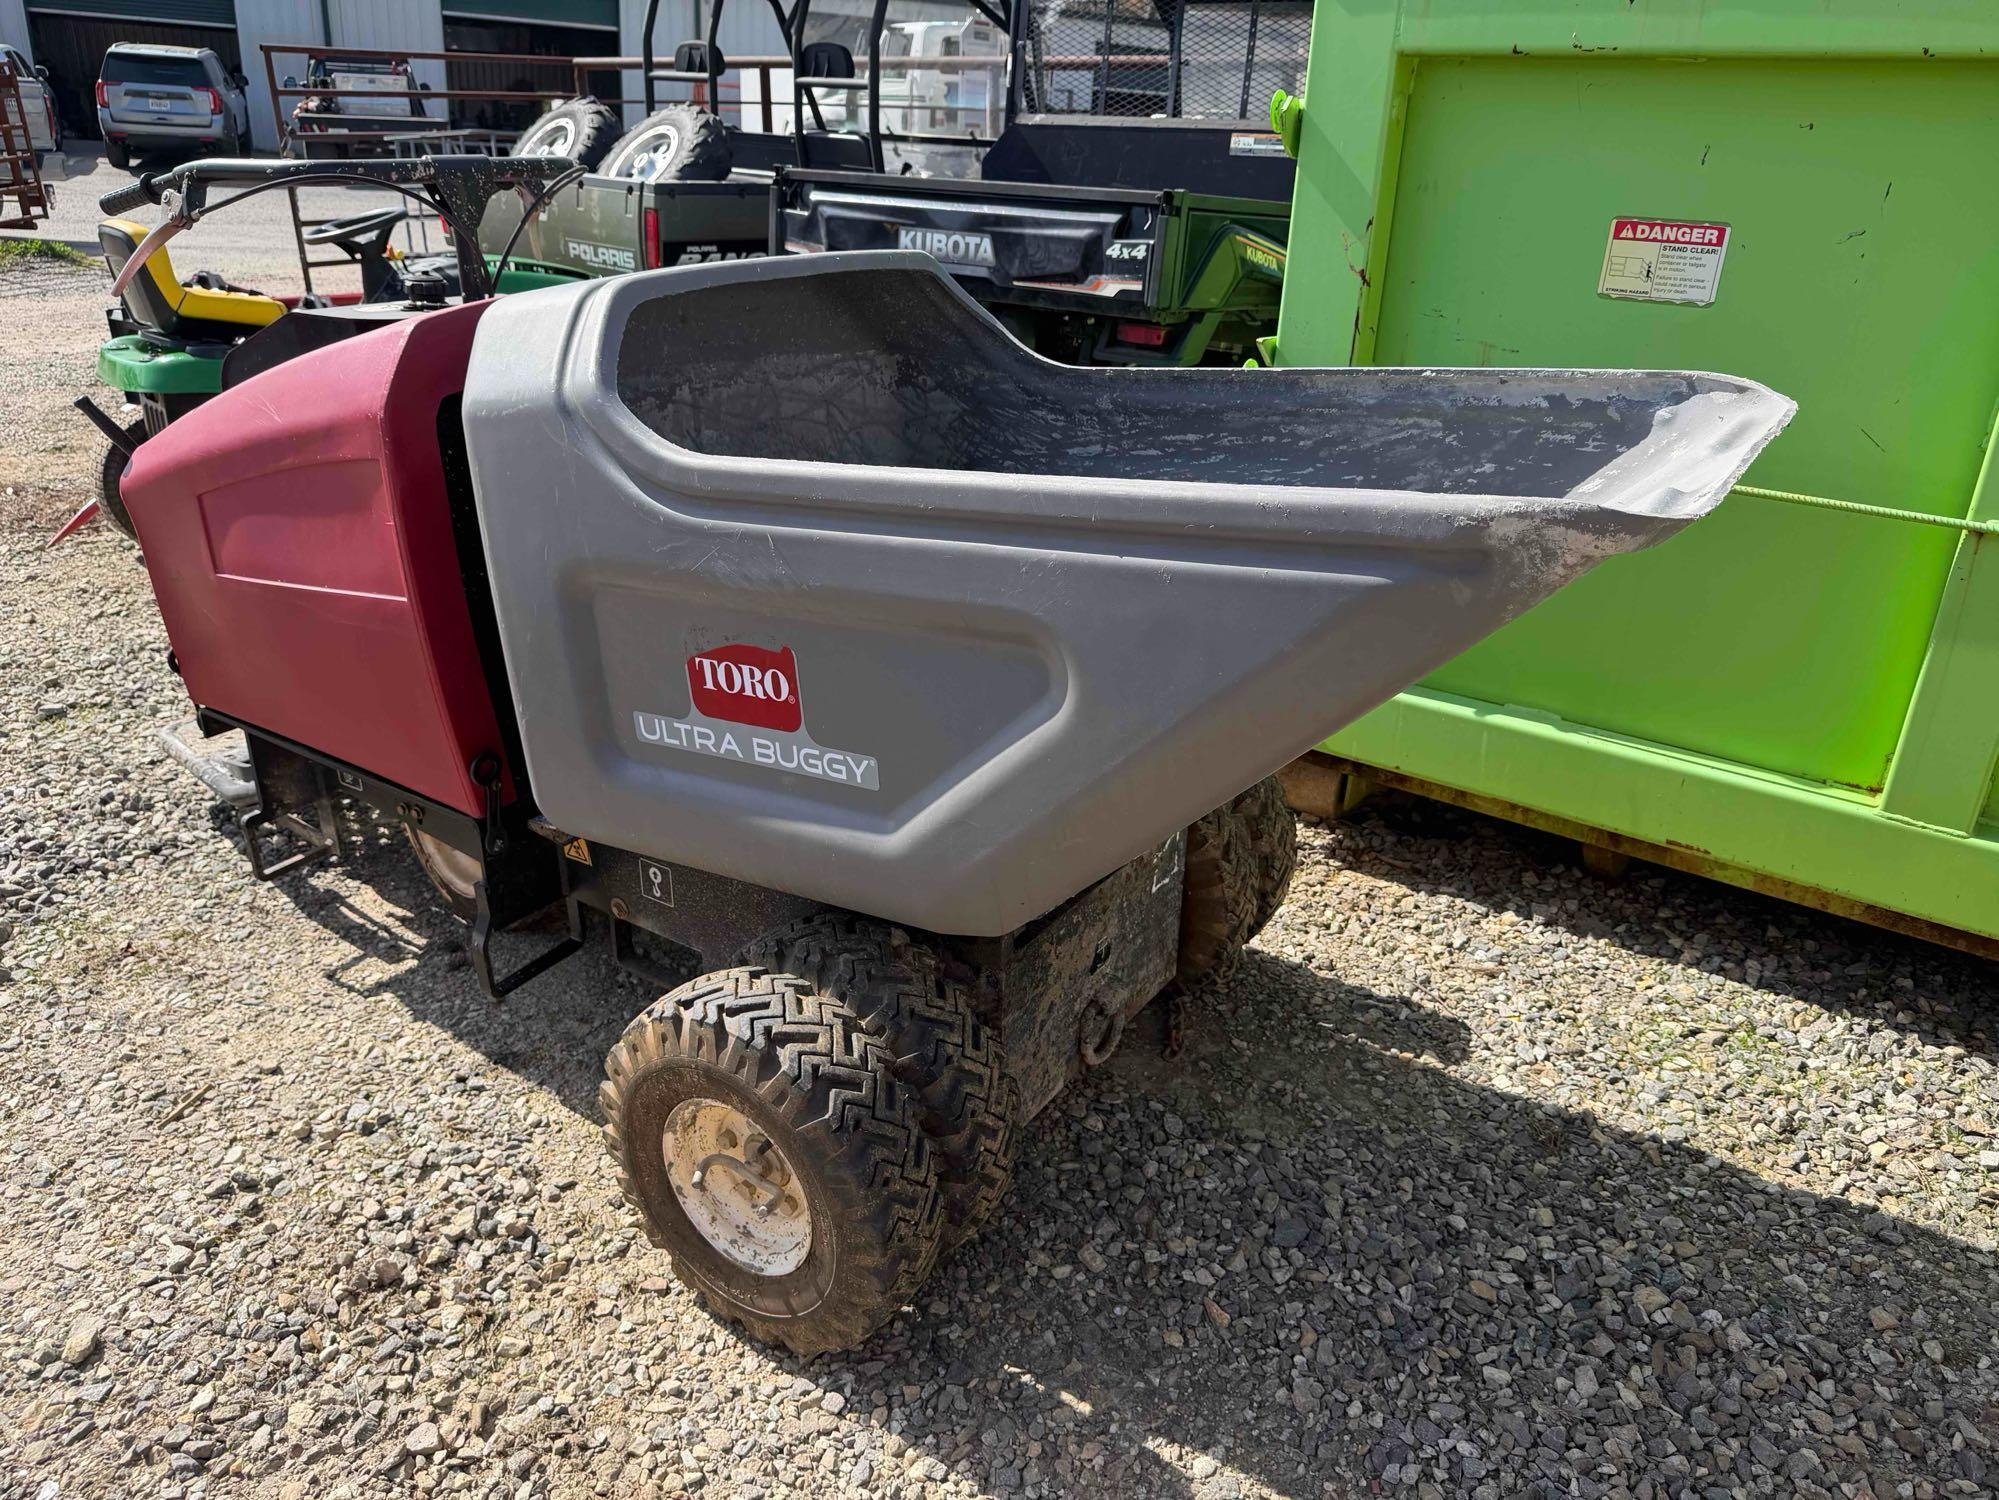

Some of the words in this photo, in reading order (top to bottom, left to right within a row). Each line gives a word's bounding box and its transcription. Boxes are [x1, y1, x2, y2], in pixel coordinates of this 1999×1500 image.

[901, 229, 995, 263] KUBOTA
[1635, 225, 1719, 243] DANGER
[568, 241, 636, 269] POLARIS
[1105, 243, 1147, 260] 4x4
[1246, 245, 1278, 271] KUBOTA
[1662, 245, 1688, 253] STAND
[1690, 247, 1719, 255] CLEAR!
[694, 656, 791, 703] TORO
[638, 715, 744, 759] ULTRA
[752, 736, 871, 784] BUGGY
